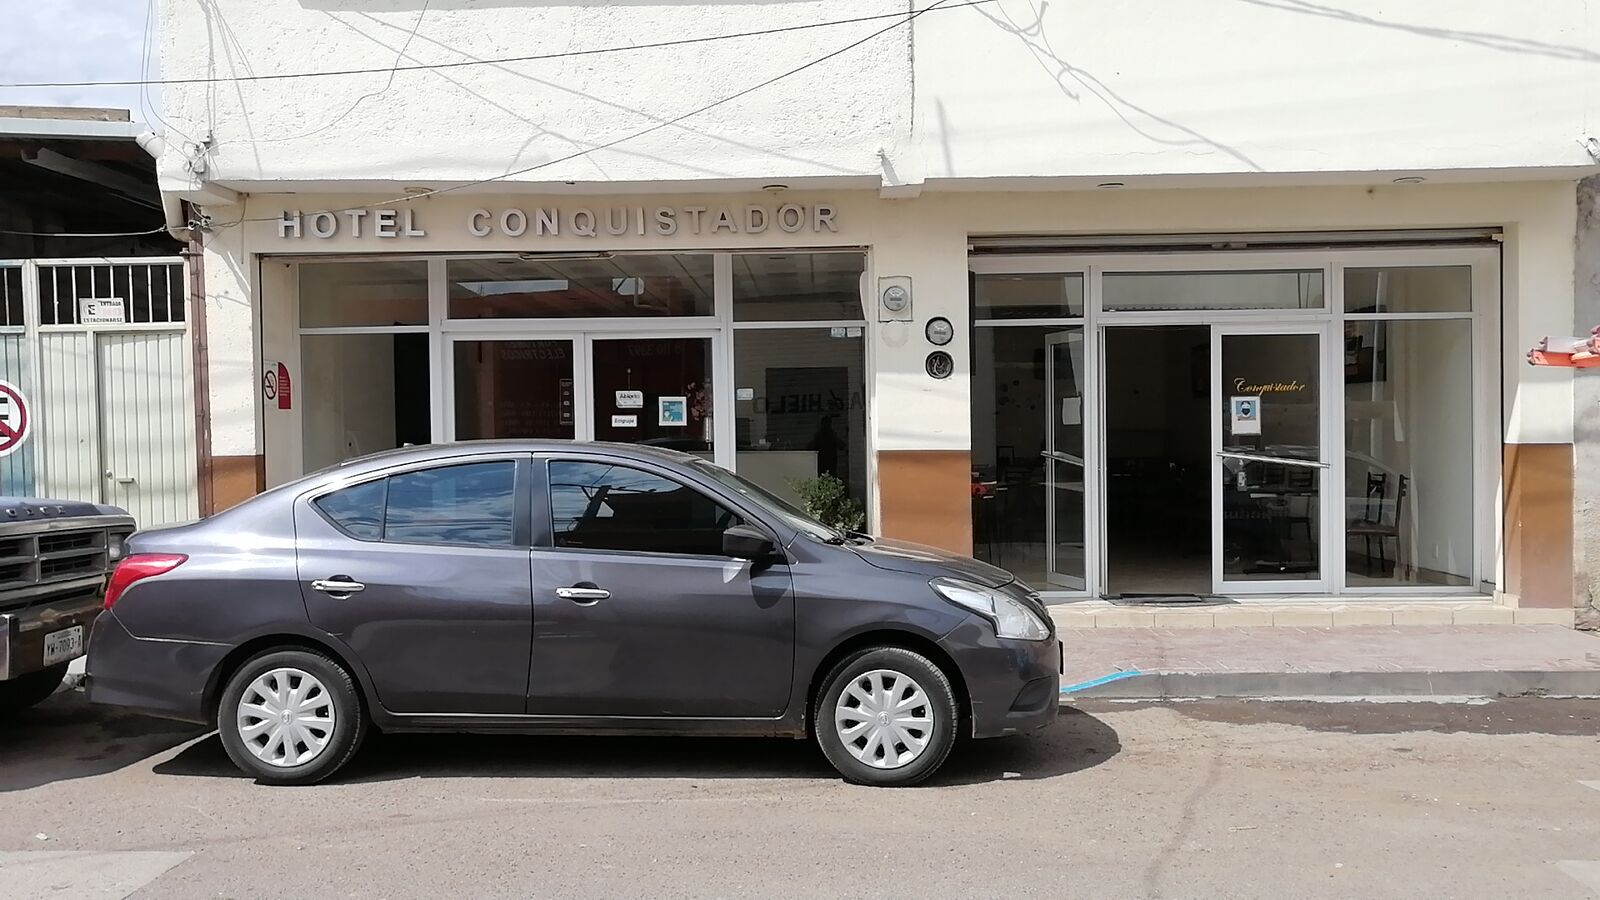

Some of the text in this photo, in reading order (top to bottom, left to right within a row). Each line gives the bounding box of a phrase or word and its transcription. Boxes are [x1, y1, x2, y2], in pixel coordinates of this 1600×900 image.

[277, 203, 839, 239] HOTEL CONQUISTADOR
[614, 417, 635, 425] Empuje
